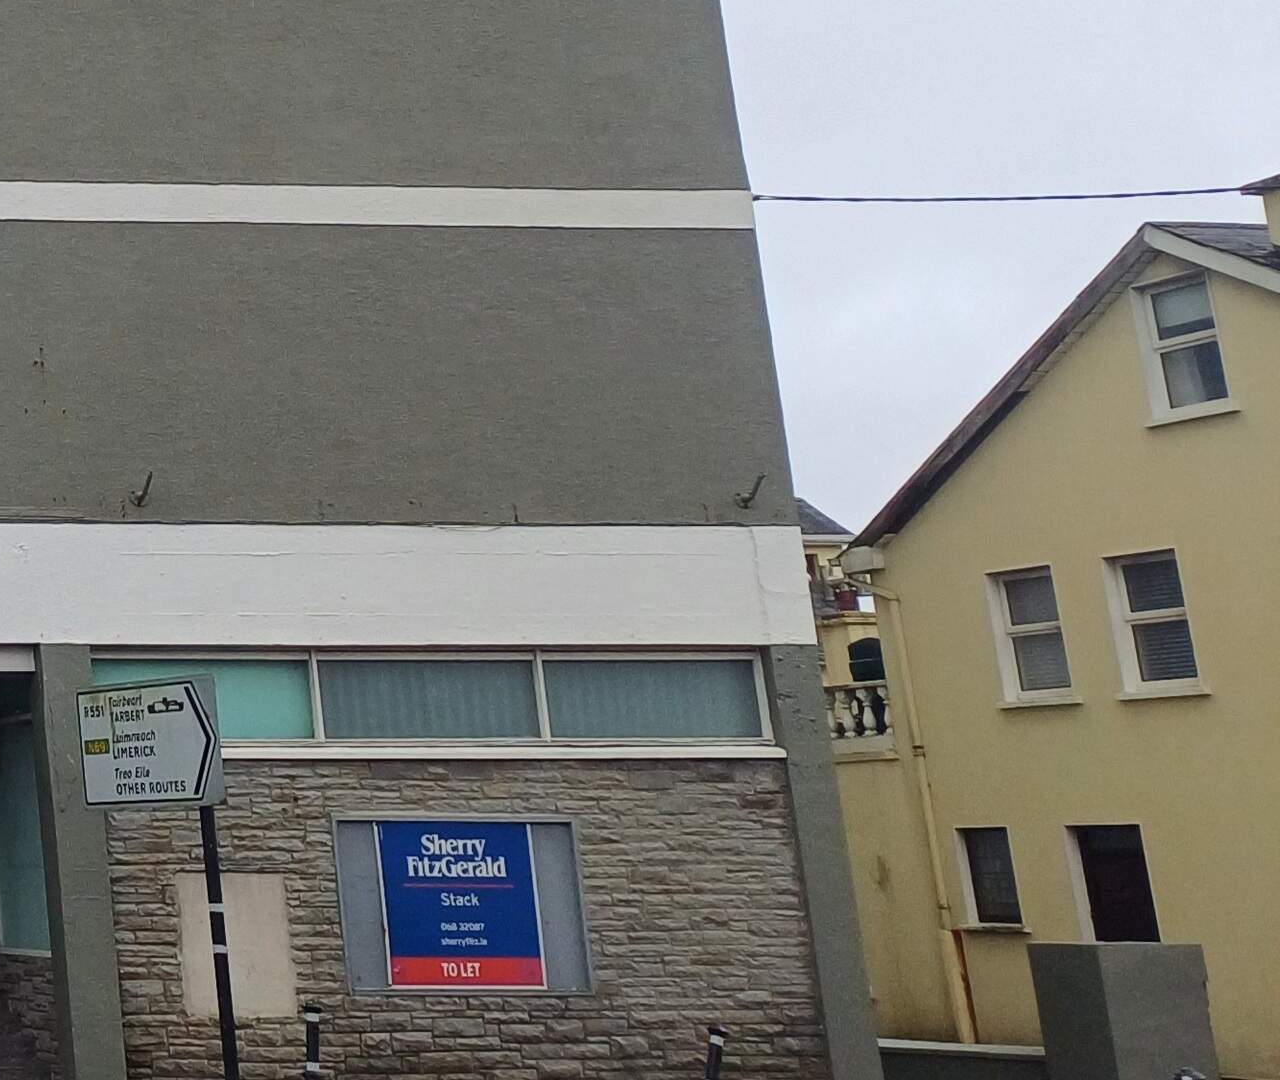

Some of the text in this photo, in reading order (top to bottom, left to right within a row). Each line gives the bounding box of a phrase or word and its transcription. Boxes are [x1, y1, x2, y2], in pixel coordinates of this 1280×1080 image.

[84, 705, 104, 718] R551
[111, 709, 144, 722] TARBERT
[88, 743, 106, 752] N69
[113, 746, 156, 760] LIMERICK
[115, 767, 150, 779] Treo Eile
[116, 780, 186, 795] OTHER ROUTES
[421, 834, 486, 860] Sherry
[406, 856, 507, 878] FitzGerald
[440, 892, 480, 906] Stack
[441, 922, 458, 931] 068
[441, 962, 480, 977] TO LET
